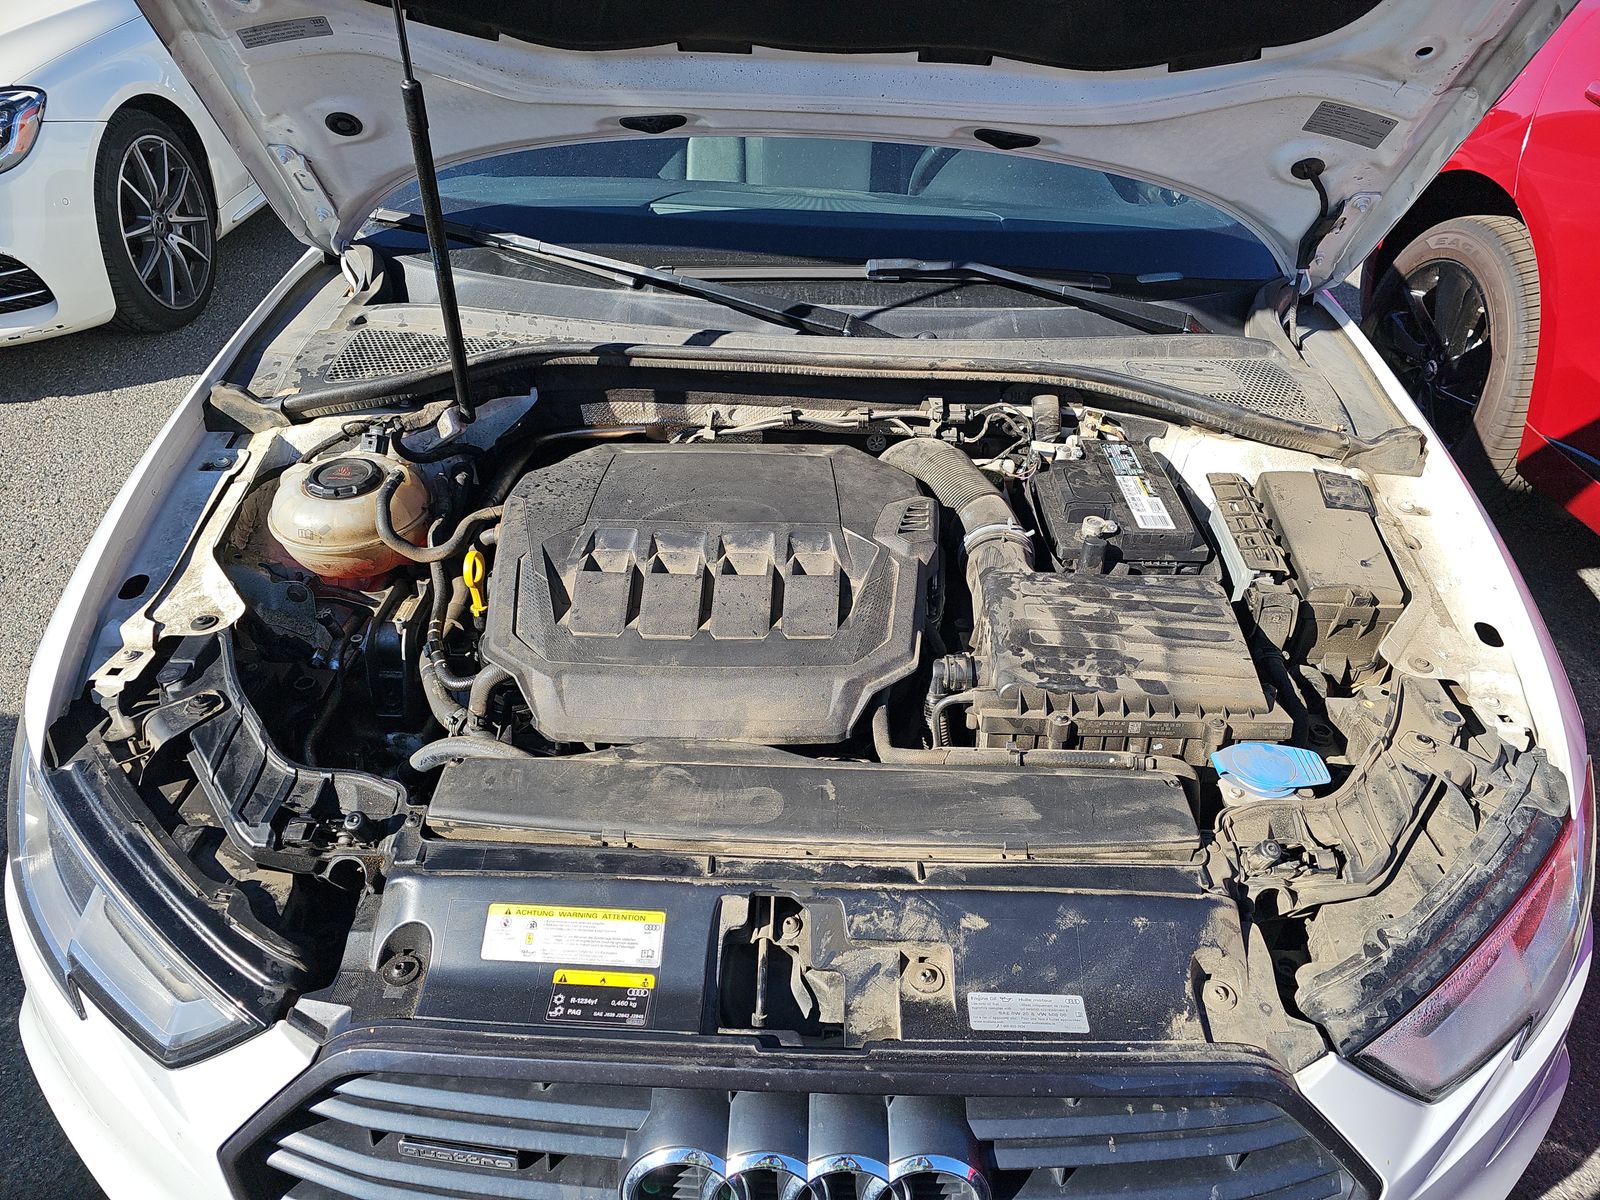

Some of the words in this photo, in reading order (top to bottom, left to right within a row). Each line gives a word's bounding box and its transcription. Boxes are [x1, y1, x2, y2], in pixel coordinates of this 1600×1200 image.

[515, 909, 554, 917] ACHTUNG
[558, 911, 598, 919] WARNING
[602, 913, 646, 921] ATTENTION
[570, 997, 598, 1005] R-1234yf
[403, 1147, 512, 1168] quattro
